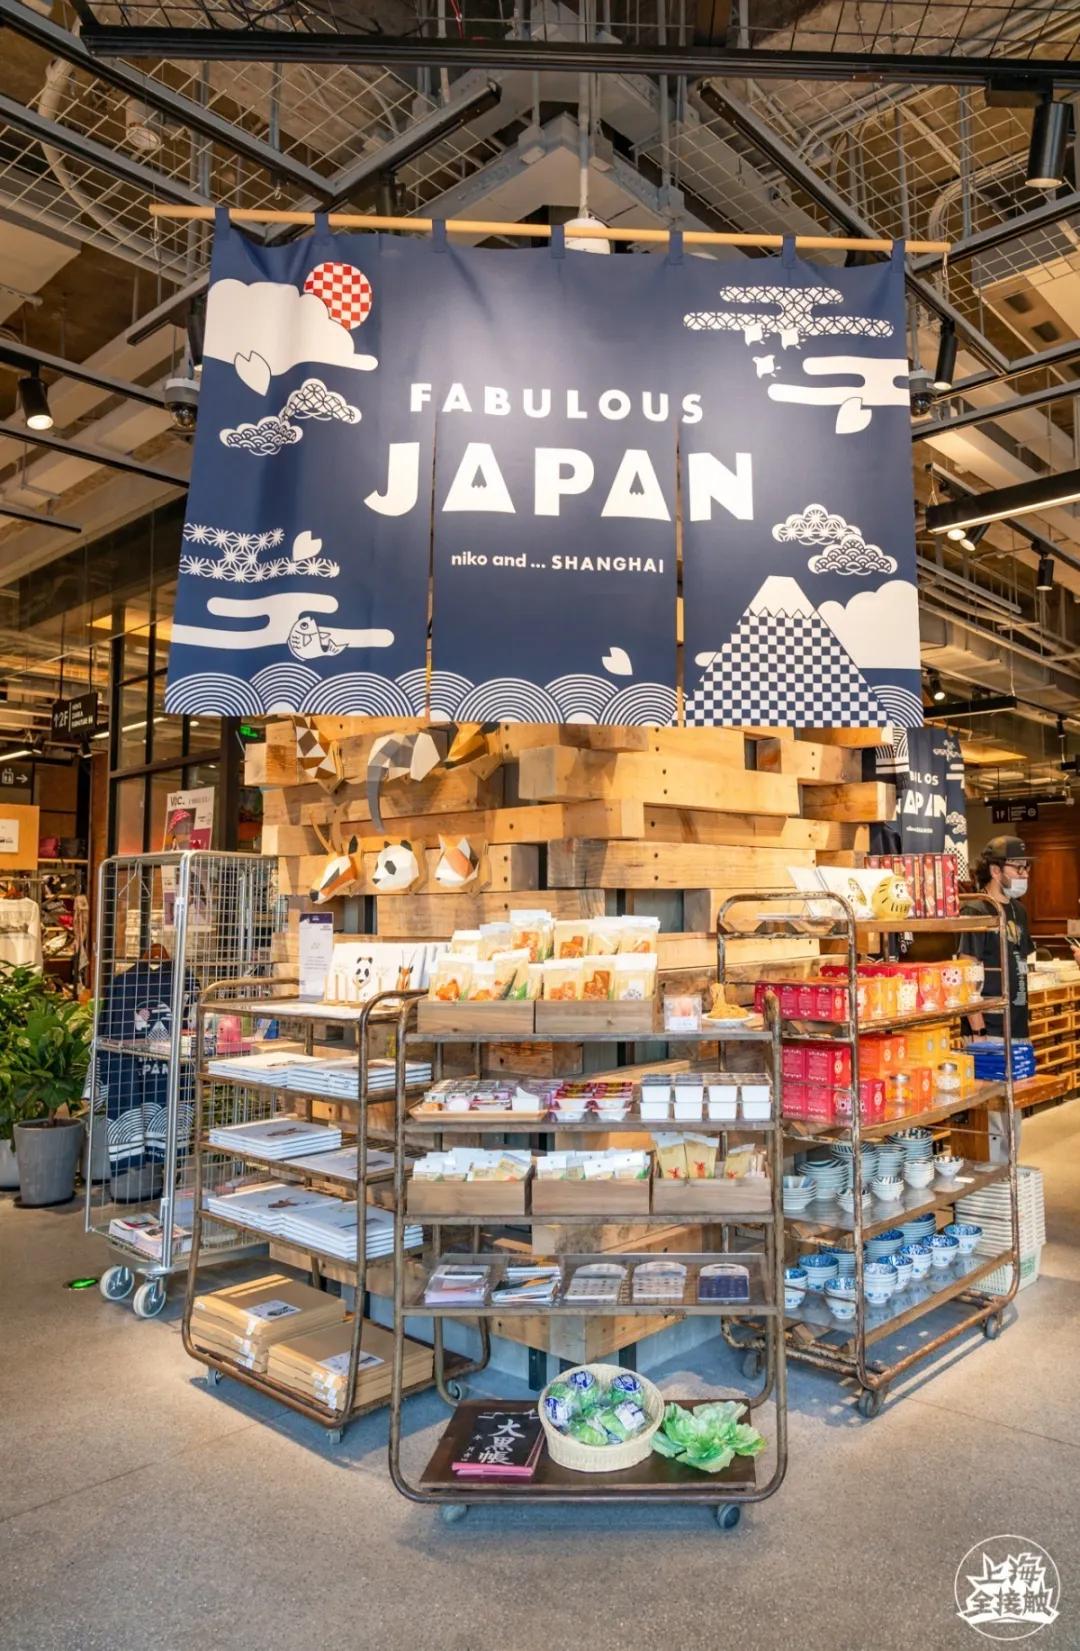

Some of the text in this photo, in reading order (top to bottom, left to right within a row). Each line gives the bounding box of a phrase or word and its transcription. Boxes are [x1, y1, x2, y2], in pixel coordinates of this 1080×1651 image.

[410, 383, 704, 424] FABULOUS
[364, 441, 754, 522] JAPAN
[451, 551, 488, 567] niko
[492, 553, 527, 568] and
[551, 555, 665, 574] SHANGHAI
